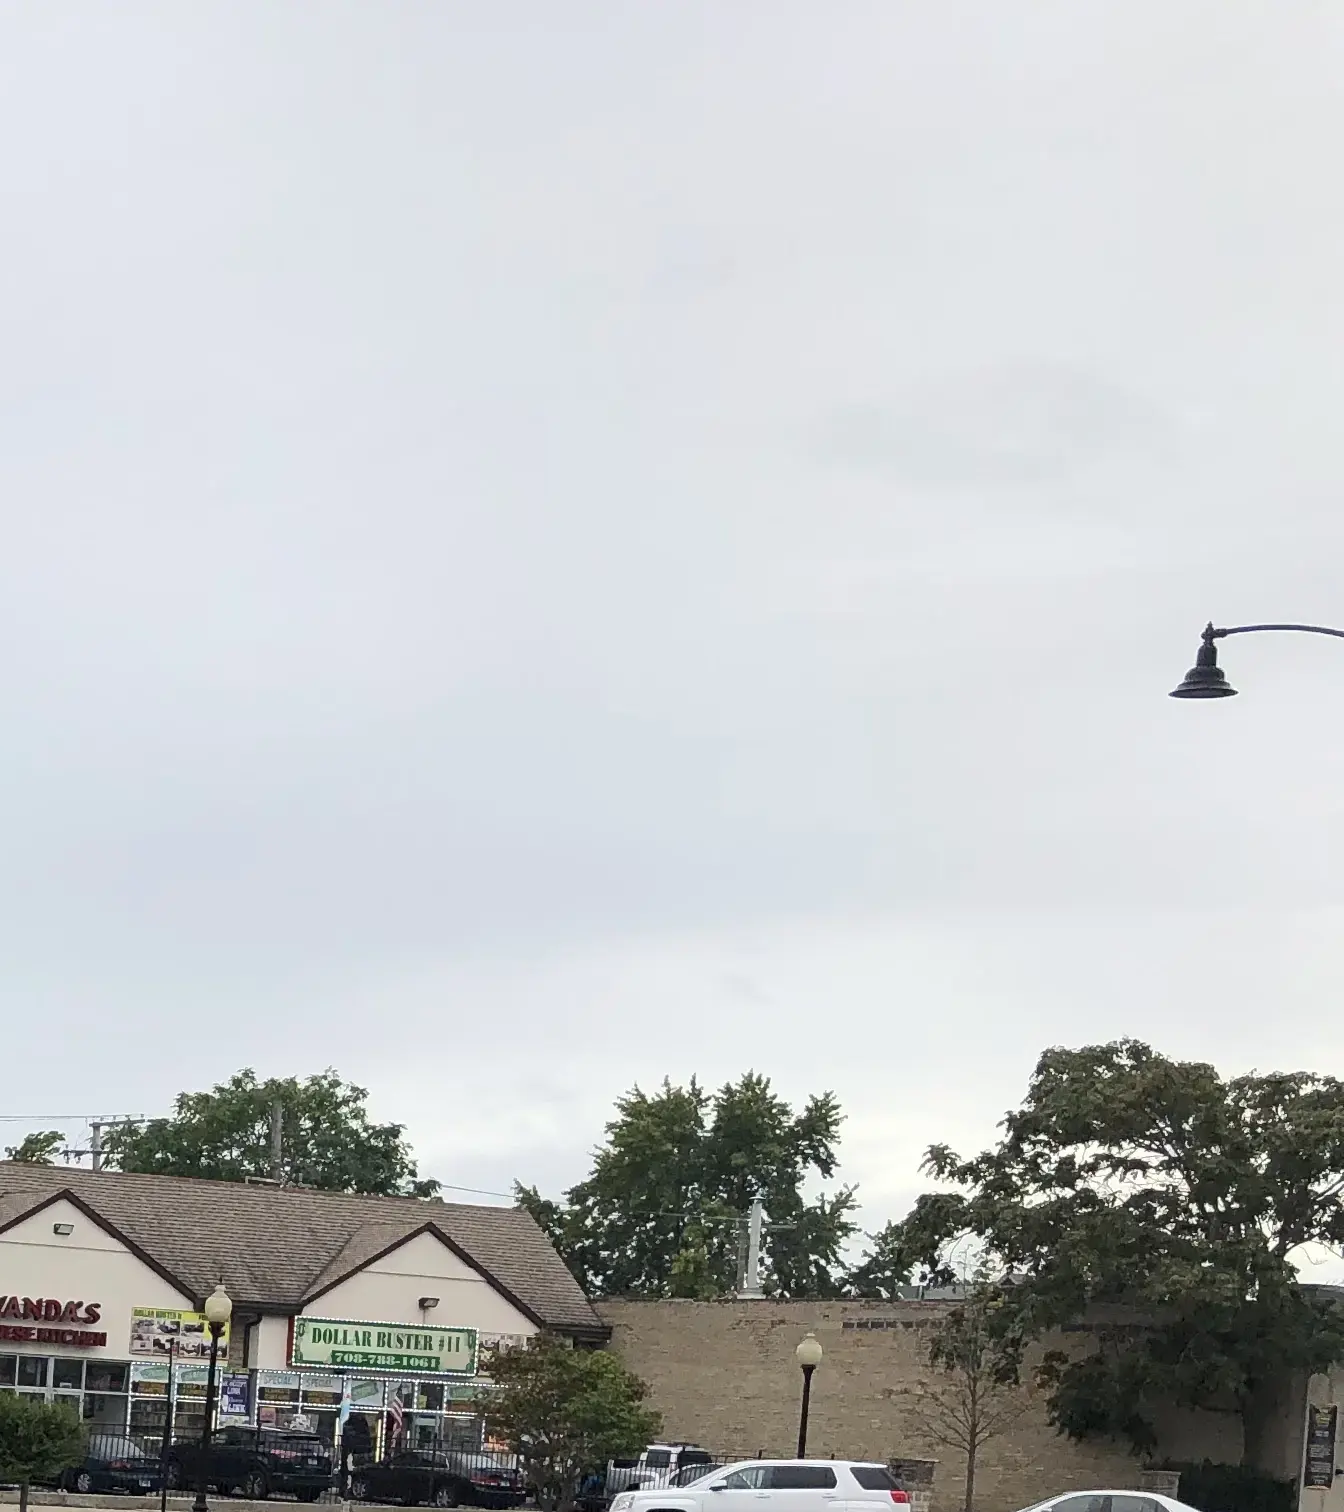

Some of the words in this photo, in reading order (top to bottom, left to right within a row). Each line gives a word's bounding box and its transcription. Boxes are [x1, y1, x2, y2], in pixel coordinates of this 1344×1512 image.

[37, 1327, 108, 1347] KITCHEN
[312, 1327, 372, 1347] DOLLAR
[376, 1331, 433, 1351] BUSTER
[334, 1352, 438, 1368] 708-788-1061
